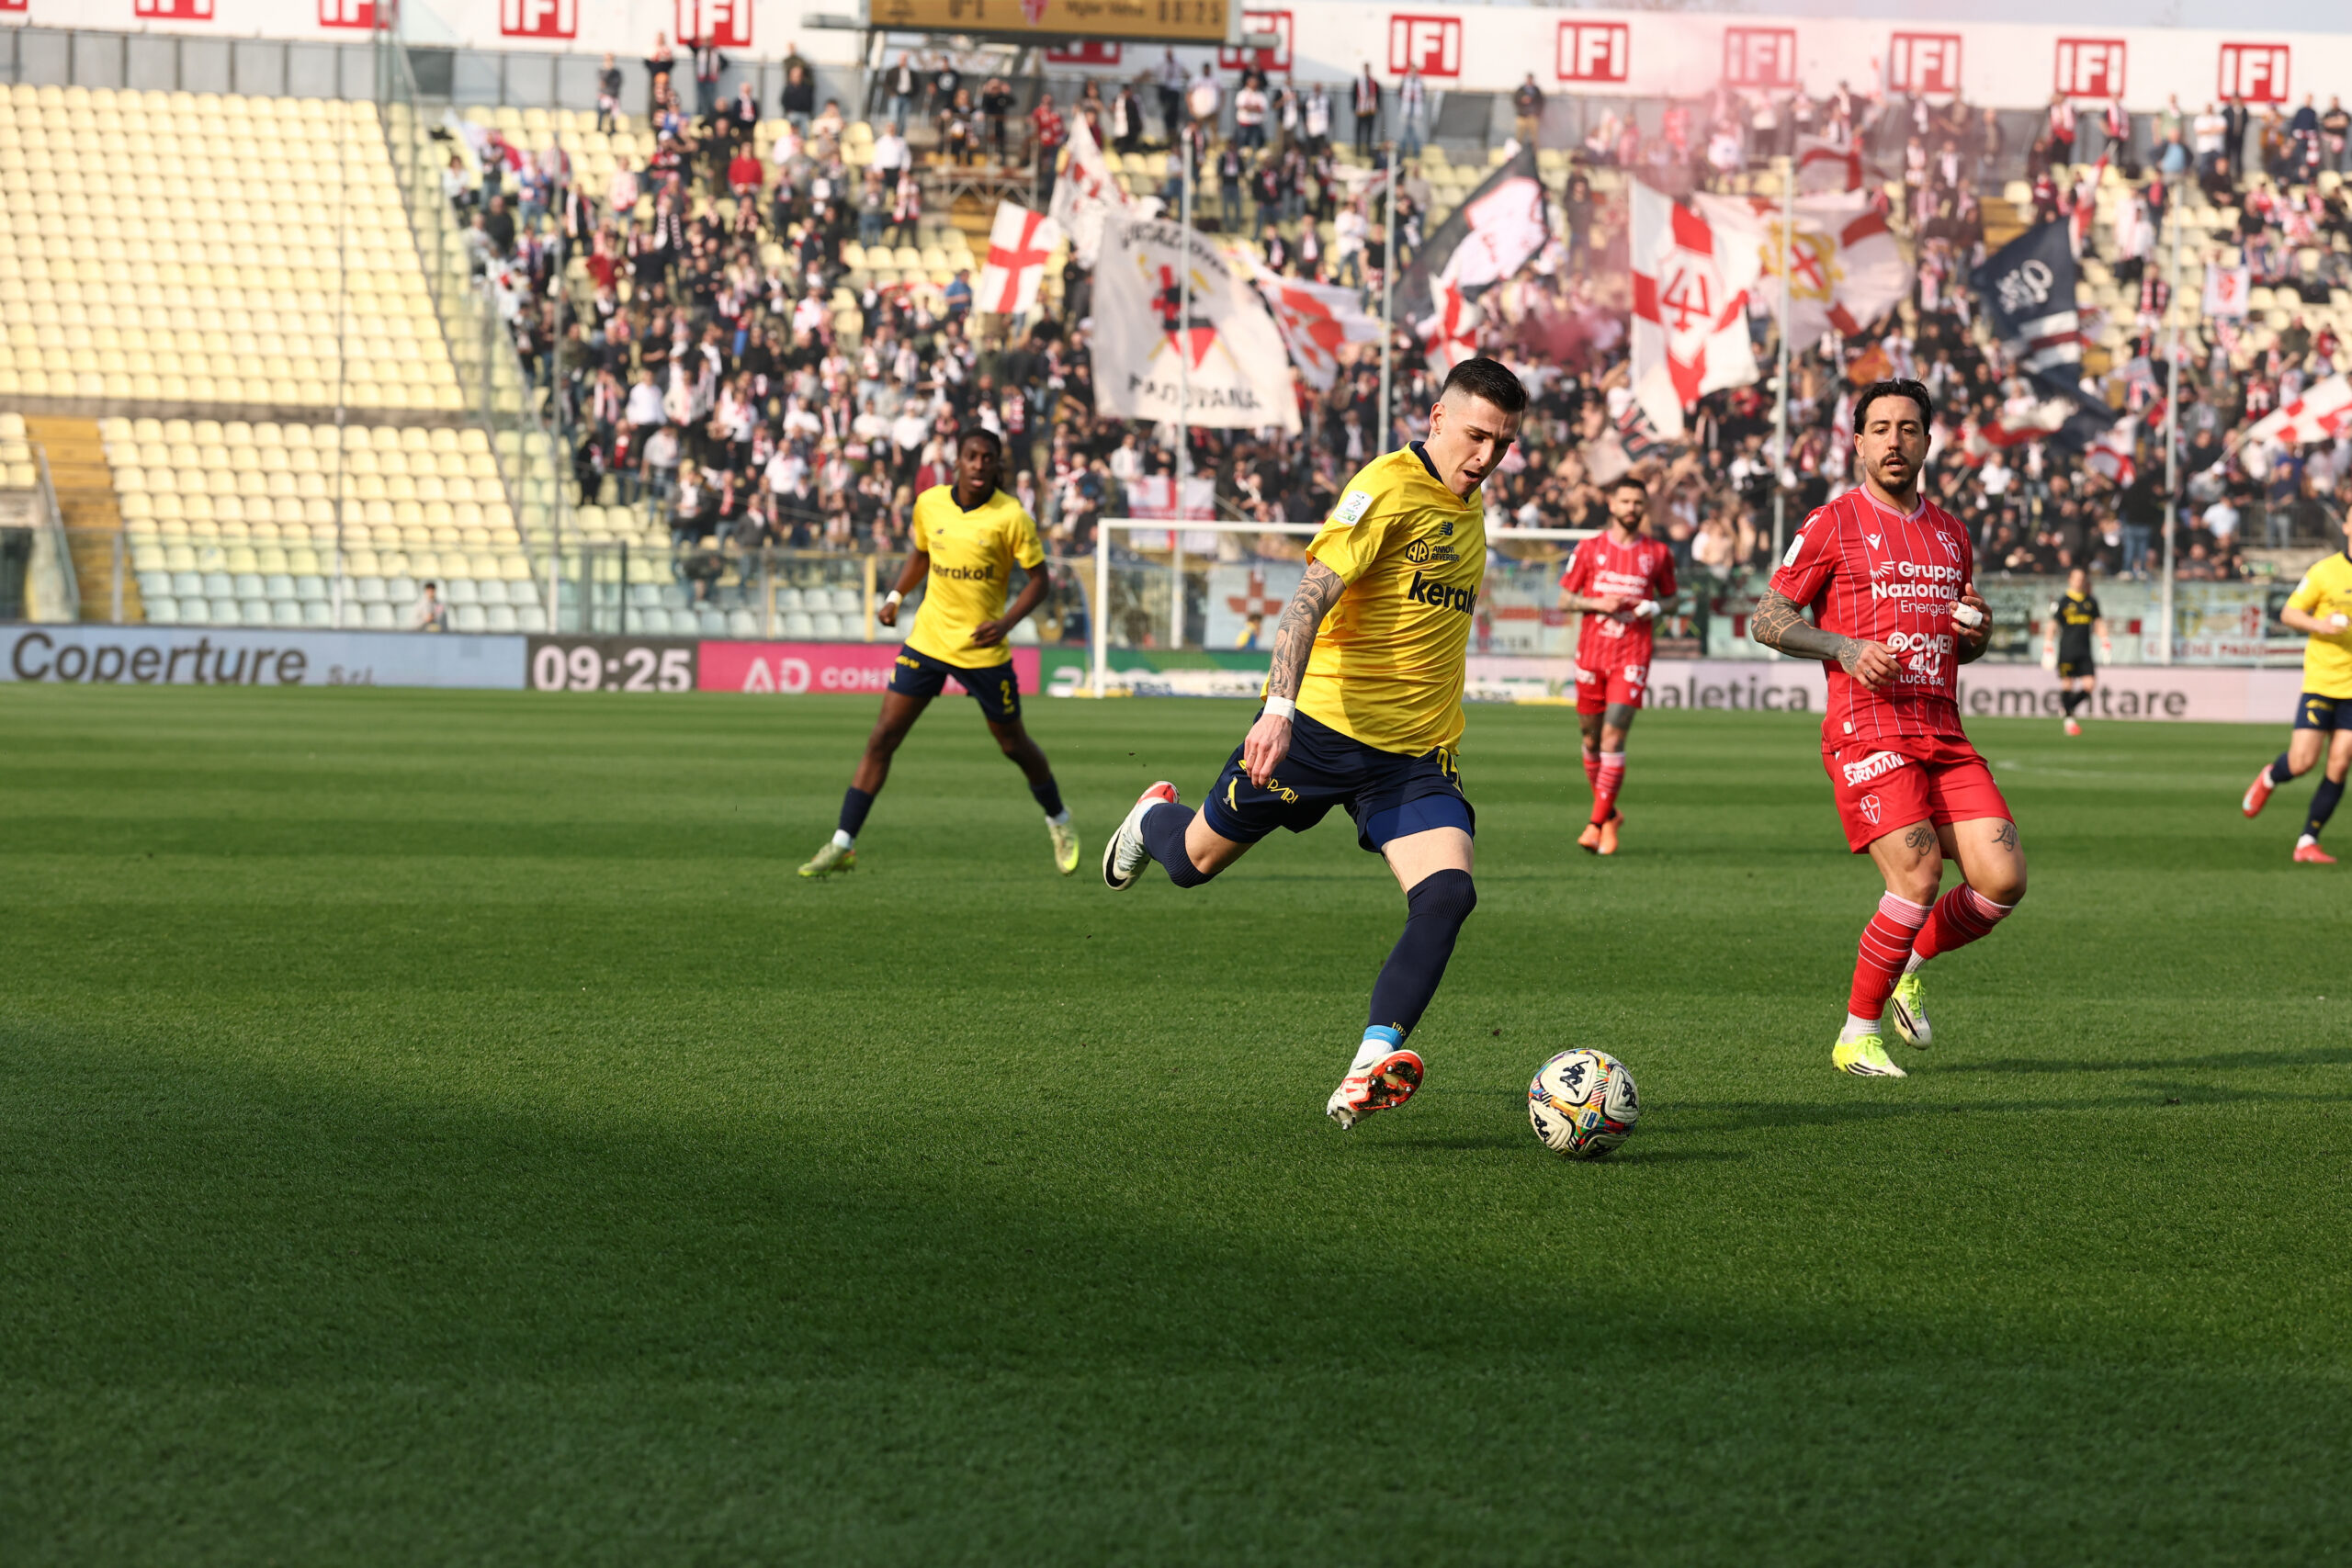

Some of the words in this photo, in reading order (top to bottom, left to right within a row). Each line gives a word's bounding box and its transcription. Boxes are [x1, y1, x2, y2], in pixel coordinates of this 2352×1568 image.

[1392, 20, 1460, 72] IFI
[1560, 26, 1626, 77] IFI
[1727, 32, 1794, 83] IFI
[1893, 38, 1960, 88] IFI
[2058, 43, 2124, 94] IFI
[2221, 49, 2288, 98] IFI
[1871, 580, 1959, 600] Nazionale
[1897, 560, 1962, 582] Gruppo
[1900, 600, 1951, 616] Energet
[12, 631, 309, 684] Coperture
[533, 644, 693, 693] 09:25
[741, 656, 812, 694] AD
[1899, 673, 1928, 684] LUCE
[1928, 674, 1945, 686] GAS
[1959, 680, 2188, 716] lemetare
[1845, 753, 1905, 787] SIRMAN
